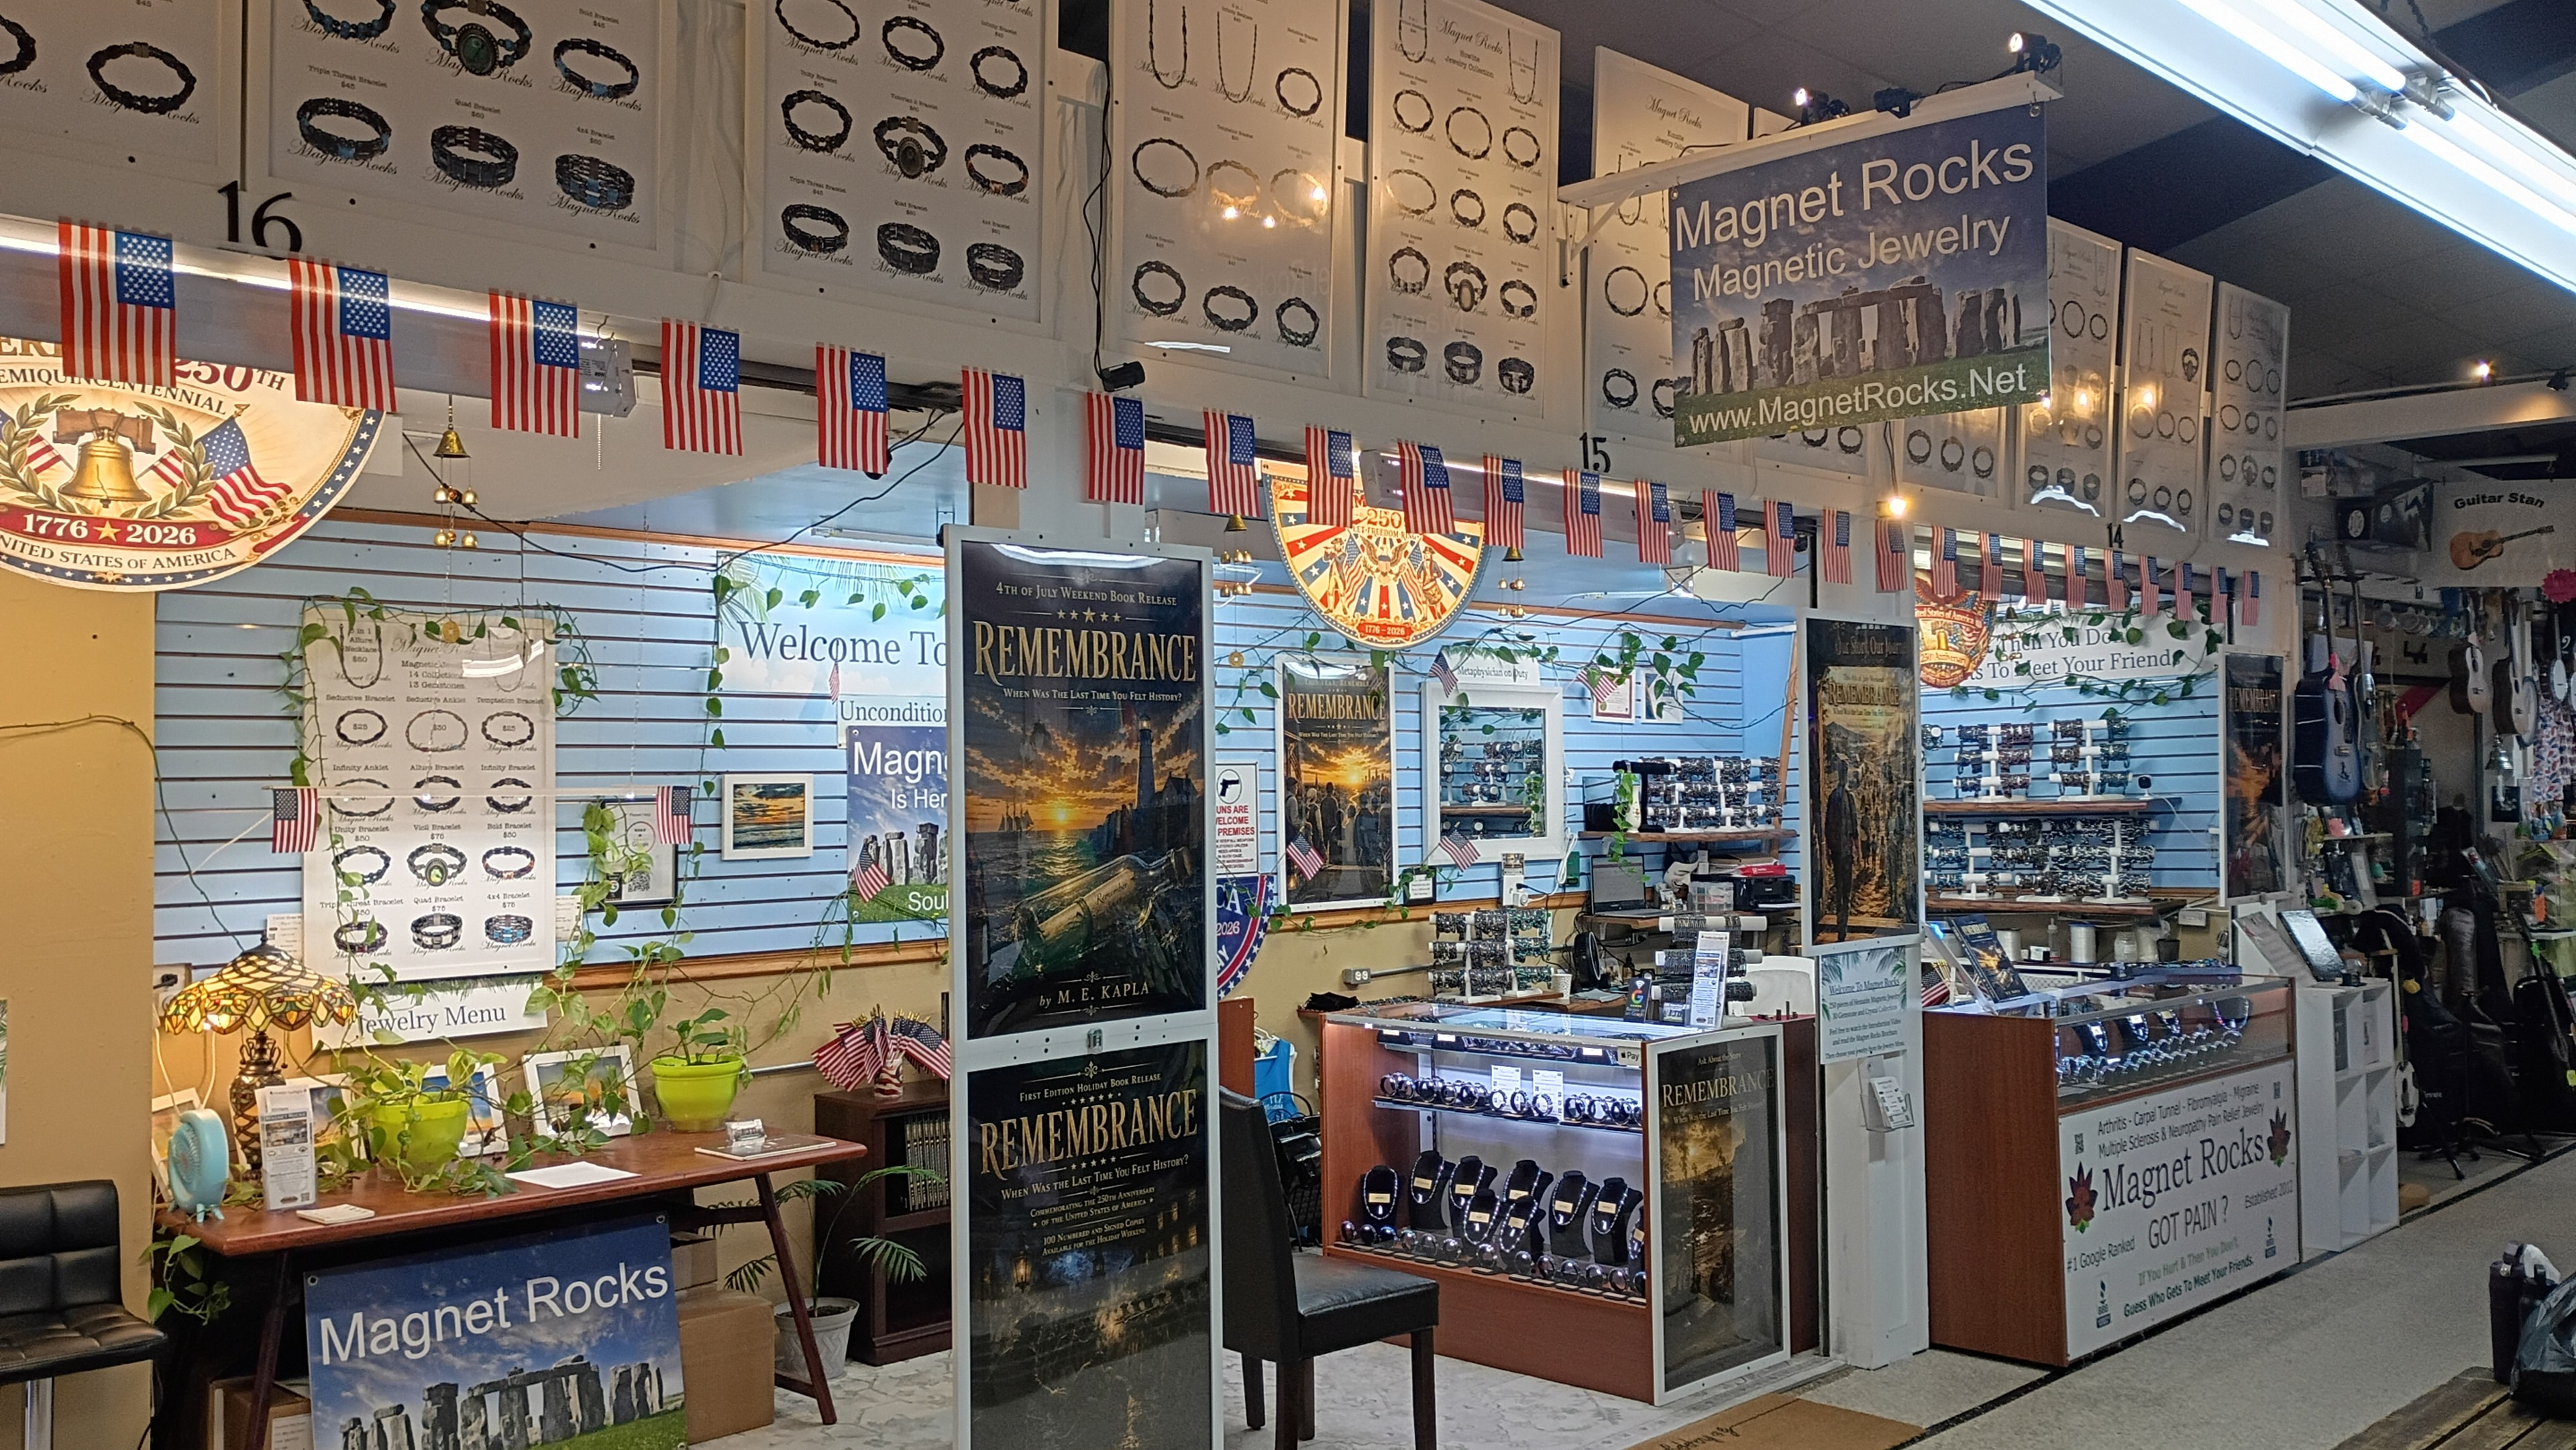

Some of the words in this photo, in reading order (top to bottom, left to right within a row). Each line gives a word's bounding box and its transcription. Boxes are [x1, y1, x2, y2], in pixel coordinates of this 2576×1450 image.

[1436, 19, 1473, 43] Magnet
[1476, 34, 1503, 55] Rocks
[547, 191, 602, 217] Magnet
[599, 203, 639, 223] Rocks
[1676, 171, 1844, 251] Magnet
[1862, 139, 2035, 210] Rocks
[218, 181, 302, 260] 16
[1693, 242, 1846, 301] Magnetic
[1858, 215, 2011, 268] Jewelry
[1689, 364, 2027, 435] www.MagnetRocks.Net
[1579, 432, 1611, 473] 15
[2454, 493, 2504, 509] Guitar
[23, 514, 89, 539] 1776
[126, 525, 197, 546] 2026
[1366, 508, 1403, 528] 250
[2107, 523, 2124, 548] 14
[60, 551, 123, 570] STATES
[127, 558, 148, 570] OF
[152, 547, 237, 569] AMERICA
[996, 582, 1018, 596] 4TH
[1021, 587, 1033, 596] OF
[1036, 585, 1057, 599] JULY
[1060, 586, 1108, 602] WEEKEND
[1110, 590, 1135, 604] BOOK
[1138, 592, 1177, 606] RELEASE
[350, 636, 373, 644] Allure
[738, 621, 900, 665] Welcome
[910, 631, 946, 666] To
[1387, 627, 1405, 635] 2026
[2046, 631, 2080, 648] You
[972, 621, 1197, 686] REMEMBRANCE
[1988, 663, 2009, 679] To
[2064, 657, 2106, 674] Your
[2110, 649, 2177, 669] Friend
[422, 671, 466, 679] Collection
[1457, 666, 1503, 678] Metaphysician
[365, 694, 396, 703] Bracelet
[476, 696, 515, 705] Temptation
[516, 696, 544, 705] Bracelet
[1004, 688, 1030, 698] WHEN
[1032, 689, 1050, 698] WAS
[1052, 689, 1068, 699] THE
[1071, 690, 1089, 700] LAST
[1091, 690, 1110, 701] TIME
[1112, 691, 1128, 701] YOU
[1130, 692, 1146, 701] FELT
[1148, 692, 1182, 703] HISTORY?
[333, 764, 361, 772] Infinity
[364, 764, 389, 772] Anklet
[891, 788, 906, 809] Is
[914, 788, 948, 809] Her
[1216, 805, 1232, 815] UNS
[1233, 805, 1248, 813] ARE
[335, 826, 356, 835] Unity
[1218, 827, 1255, 836] PREMISES
[413, 896, 431, 904] Quad
[434, 895, 464, 903] Bracelet
[502, 891, 530, 899] Bracelet
[1039, 994, 1051, 1007] by
[1057, 990, 1075, 1004] M.
[1081, 987, 1095, 1000] E.
[1101, 981, 1149, 999] KAPLA
[358, 1012, 438, 1037] Jewelry
[445, 1005, 506, 1027] Menu
[1627, 1051, 1639, 1061] Pay
[1020, 1091, 1040, 1102] FIRST
[1044, 1086, 1074, 1099] EDITION
[1077, 1082, 1108, 1094] HOLIDAY
[1110, 1078, 1129, 1089] BOOK
[1131, 1074, 1161, 1085] RELEASE
[1662, 1068, 1774, 1107] REMEMBRANCE
[2098, 1115, 2127, 1136] Arthritis
[2134, 1108, 2157, 1127] Carpal
[2159, 1102, 2181, 1121] Tunnel
[2187, 1092, 2228, 1113] Fibromyalgia
[2233, 1082, 2259, 1102] Migraine
[980, 1088, 1197, 1180] REMEMBRANCE
[2098, 1137, 2127, 1158] Multiple
[2129, 1133, 2159, 1151] Sclerosis
[2169, 1118, 2206, 1141] Neuropathy
[1002, 1188, 1028, 1200] WHEN
[1032, 1182, 1051, 1195] WAS
[1053, 1180, 1069, 1190] THE
[1072, 1175, 1091, 1188] LAST
[1093, 1170, 1113, 1183] TIME
[1114, 1167, 1130, 1179] YOU
[1132, 1163, 1150, 1176] FELT
[1153, 1154, 1189, 1171] HISTORY?
[2103, 1147, 2192, 1212] Magnet
[2200, 1128, 2265, 1180] Rocks
[2148, 1211, 2178, 1249] GOT
[2184, 1199, 2217, 1237] PAIN
[2222, 1195, 2229, 1223] ?
[2080, 1247, 2107, 1269] Google
[2108, 1237, 2135, 1259] Ranked
[2124, 1300, 2147, 1318] Guess
[2148, 1292, 2165, 1309] Who
[2166, 1283, 2182, 1300] Gets
[2184, 1278, 2192, 1291] To
[320, 1286, 511, 1365] Magnet
[526, 1262, 669, 1324] Rocks
